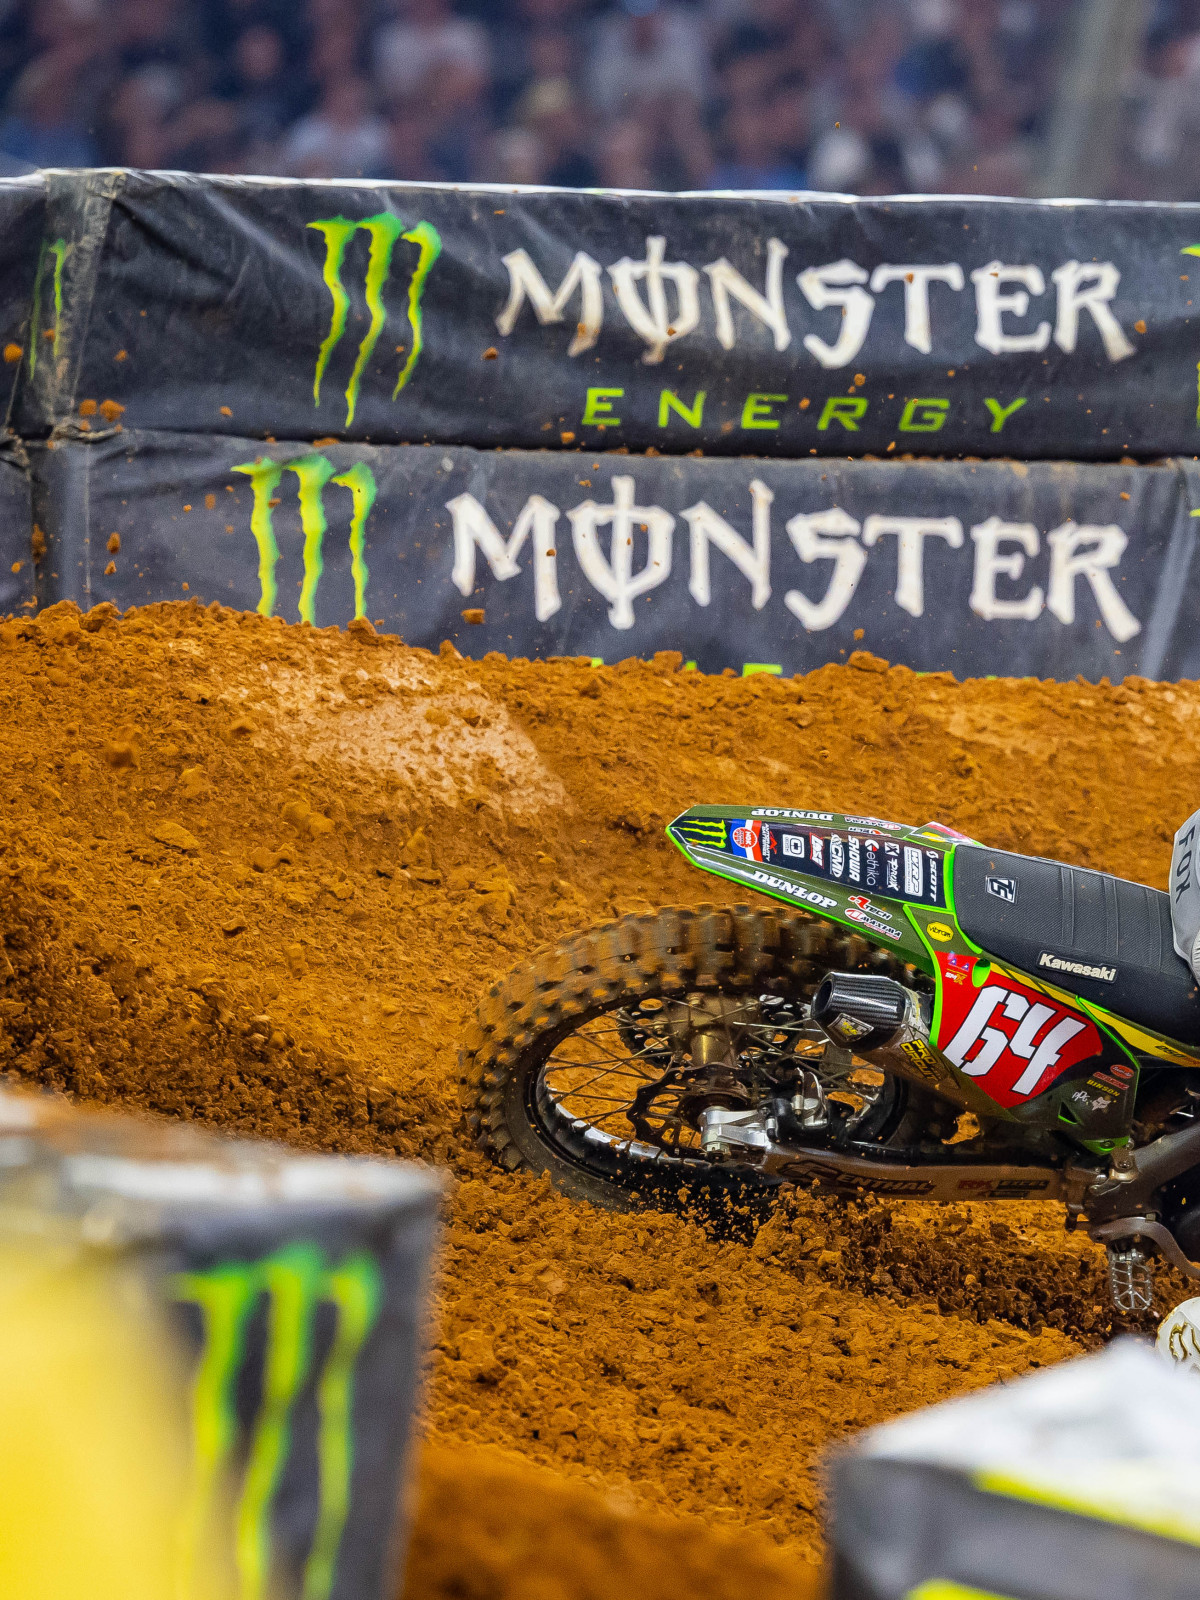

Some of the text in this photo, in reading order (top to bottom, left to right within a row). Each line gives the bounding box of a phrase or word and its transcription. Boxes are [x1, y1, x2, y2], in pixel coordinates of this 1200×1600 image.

[496, 236, 1136, 368] MONSTER
[581, 387, 1027, 434] ENERGY
[446, 475, 1142, 643] MONSTER
[751, 808, 834, 821] DUNLOP
[848, 835, 860, 882] SHOWA
[866, 852, 880, 886] ethika
[910, 849, 920, 893] WRP
[929, 858, 937, 902] SCOTT
[1175, 825, 1196, 904] FOX
[751, 870, 838, 909] DUNLOP
[1039, 953, 1117, 981] Kawasaki
[900, 1042, 937, 1081] CIRCUIT
[911, 1040, 938, 1065] PRO
[941, 984, 1087, 1096] 64
